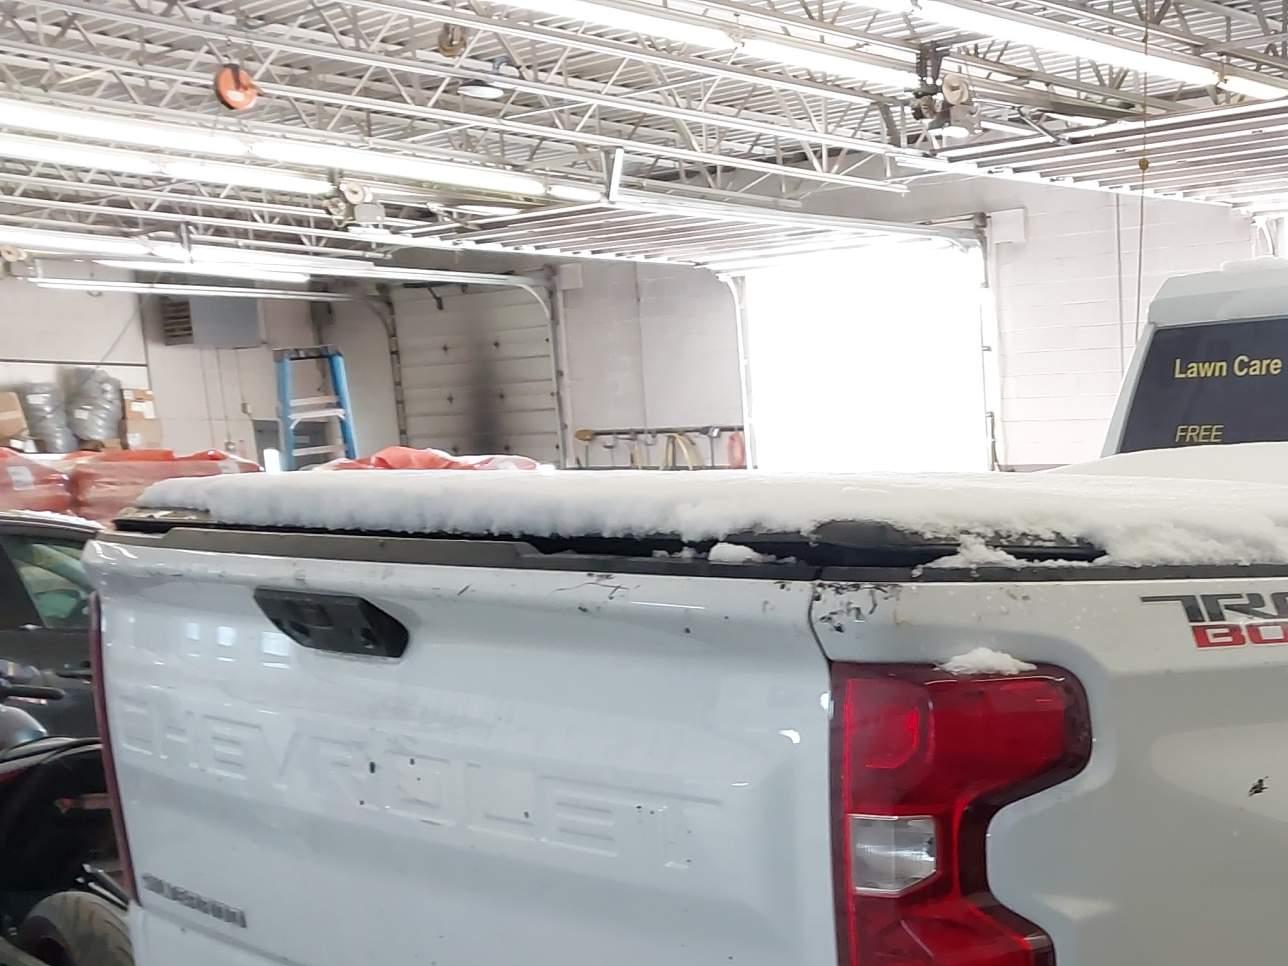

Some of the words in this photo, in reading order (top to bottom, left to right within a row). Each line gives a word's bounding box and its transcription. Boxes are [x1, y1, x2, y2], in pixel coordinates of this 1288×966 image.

[1174, 358, 1227, 378] Lawn
[1233, 355, 1282, 377] Care
[1175, 424, 1225, 442] FREE
